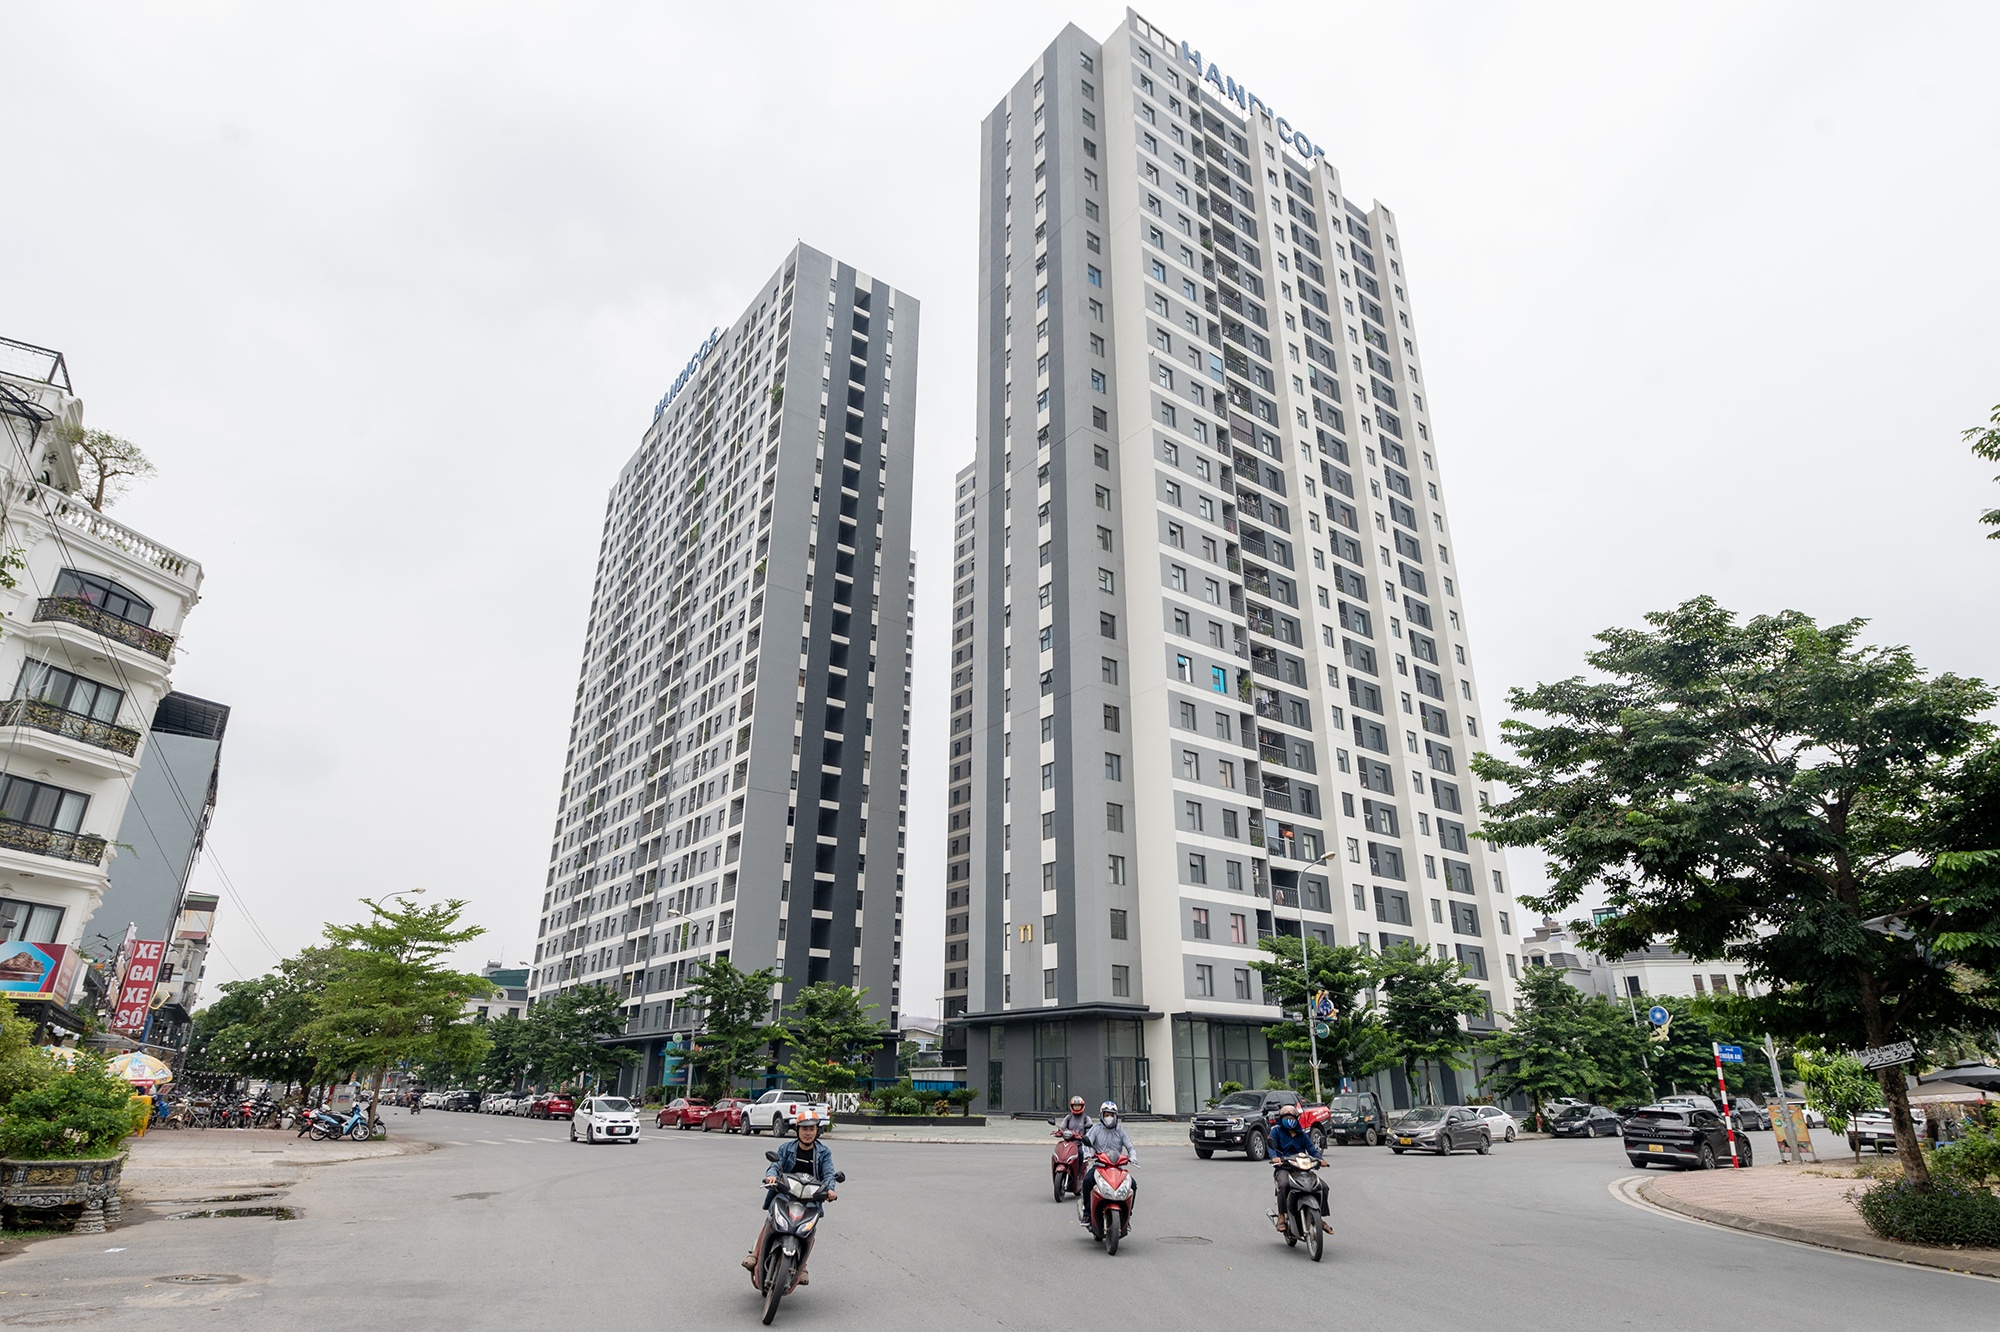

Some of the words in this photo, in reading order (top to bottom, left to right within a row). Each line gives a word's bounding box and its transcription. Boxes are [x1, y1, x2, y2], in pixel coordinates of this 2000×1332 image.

[1019, 924, 1033, 943] T1
[135, 943, 161, 959] XE
[129, 965, 154, 981] GA
[122, 987, 149, 1004] XE
[117, 1005, 146, 1027] SỐ
